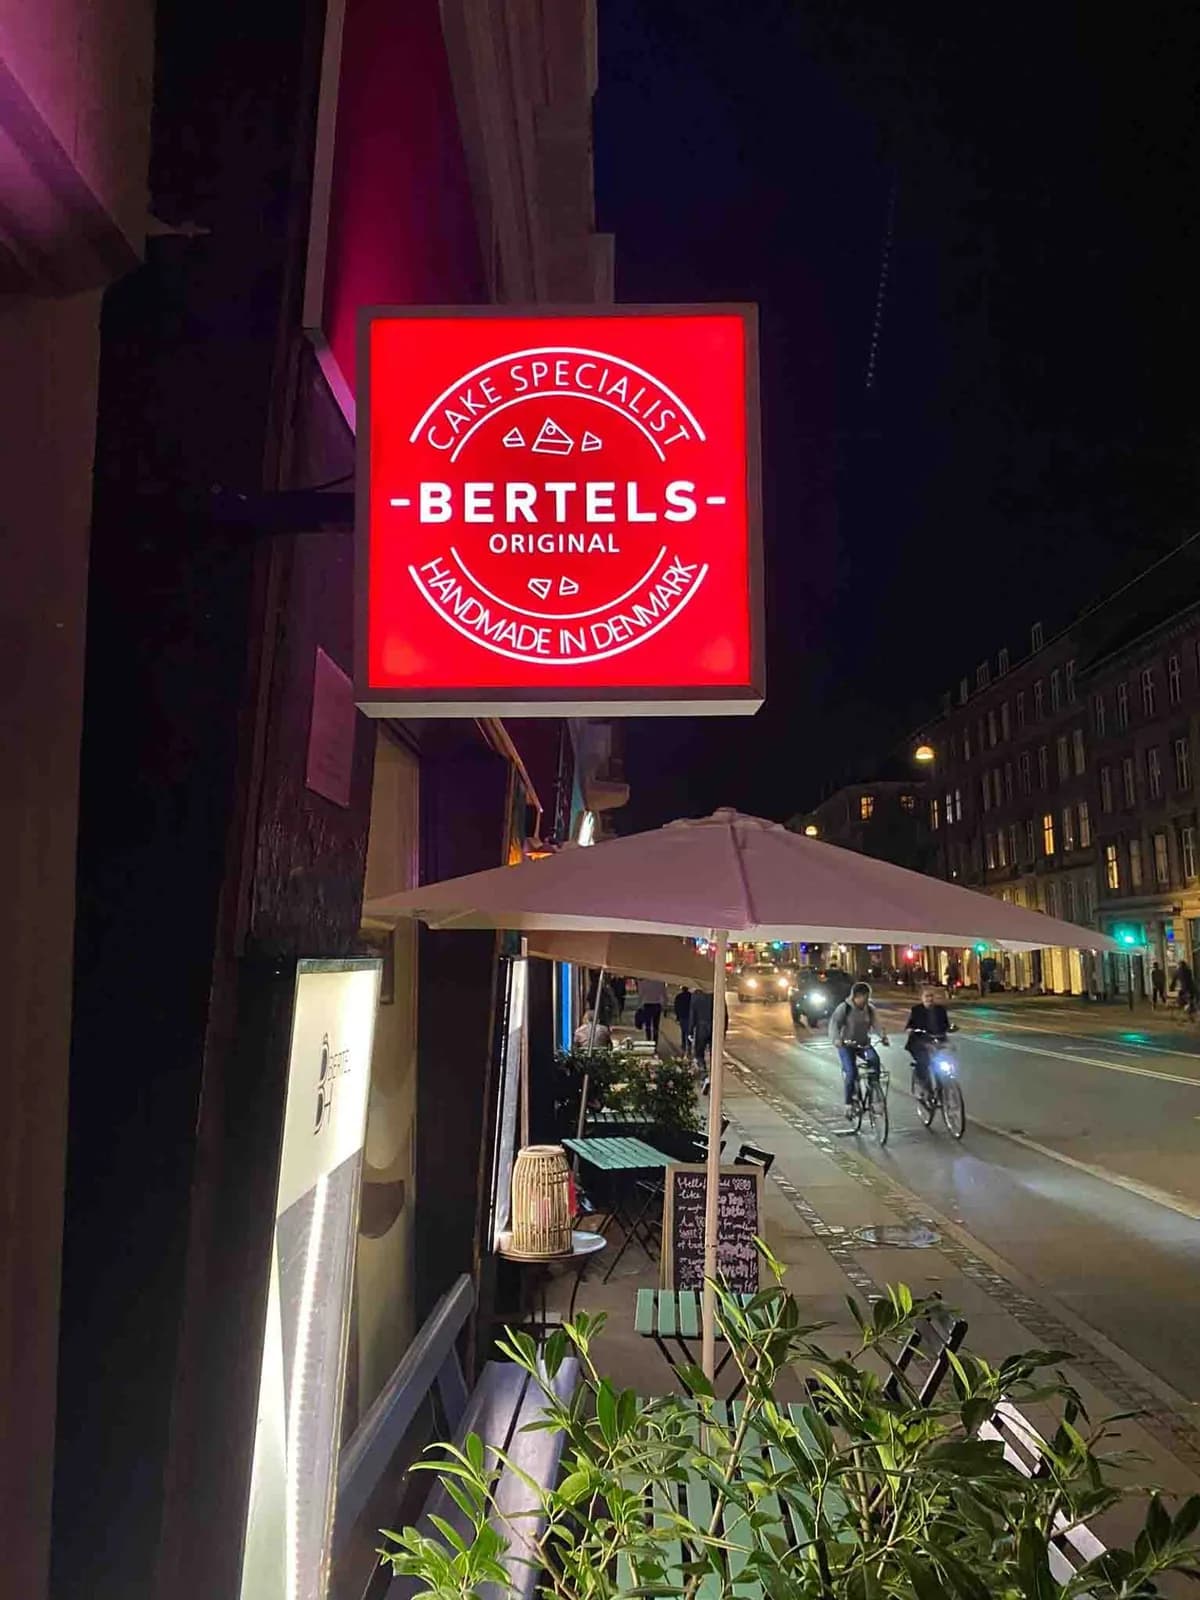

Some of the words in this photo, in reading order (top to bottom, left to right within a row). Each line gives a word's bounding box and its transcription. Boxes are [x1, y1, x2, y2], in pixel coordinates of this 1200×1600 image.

[427, 377, 502, 451] CAKE
[509, 360, 691, 448] SPECIALIST
[488, 533, 620, 555] ORIGINAL
[420, 556, 552, 655] HANDMADE
[559, 629, 587, 655] IN
[590, 555, 698, 648] DENMARK
